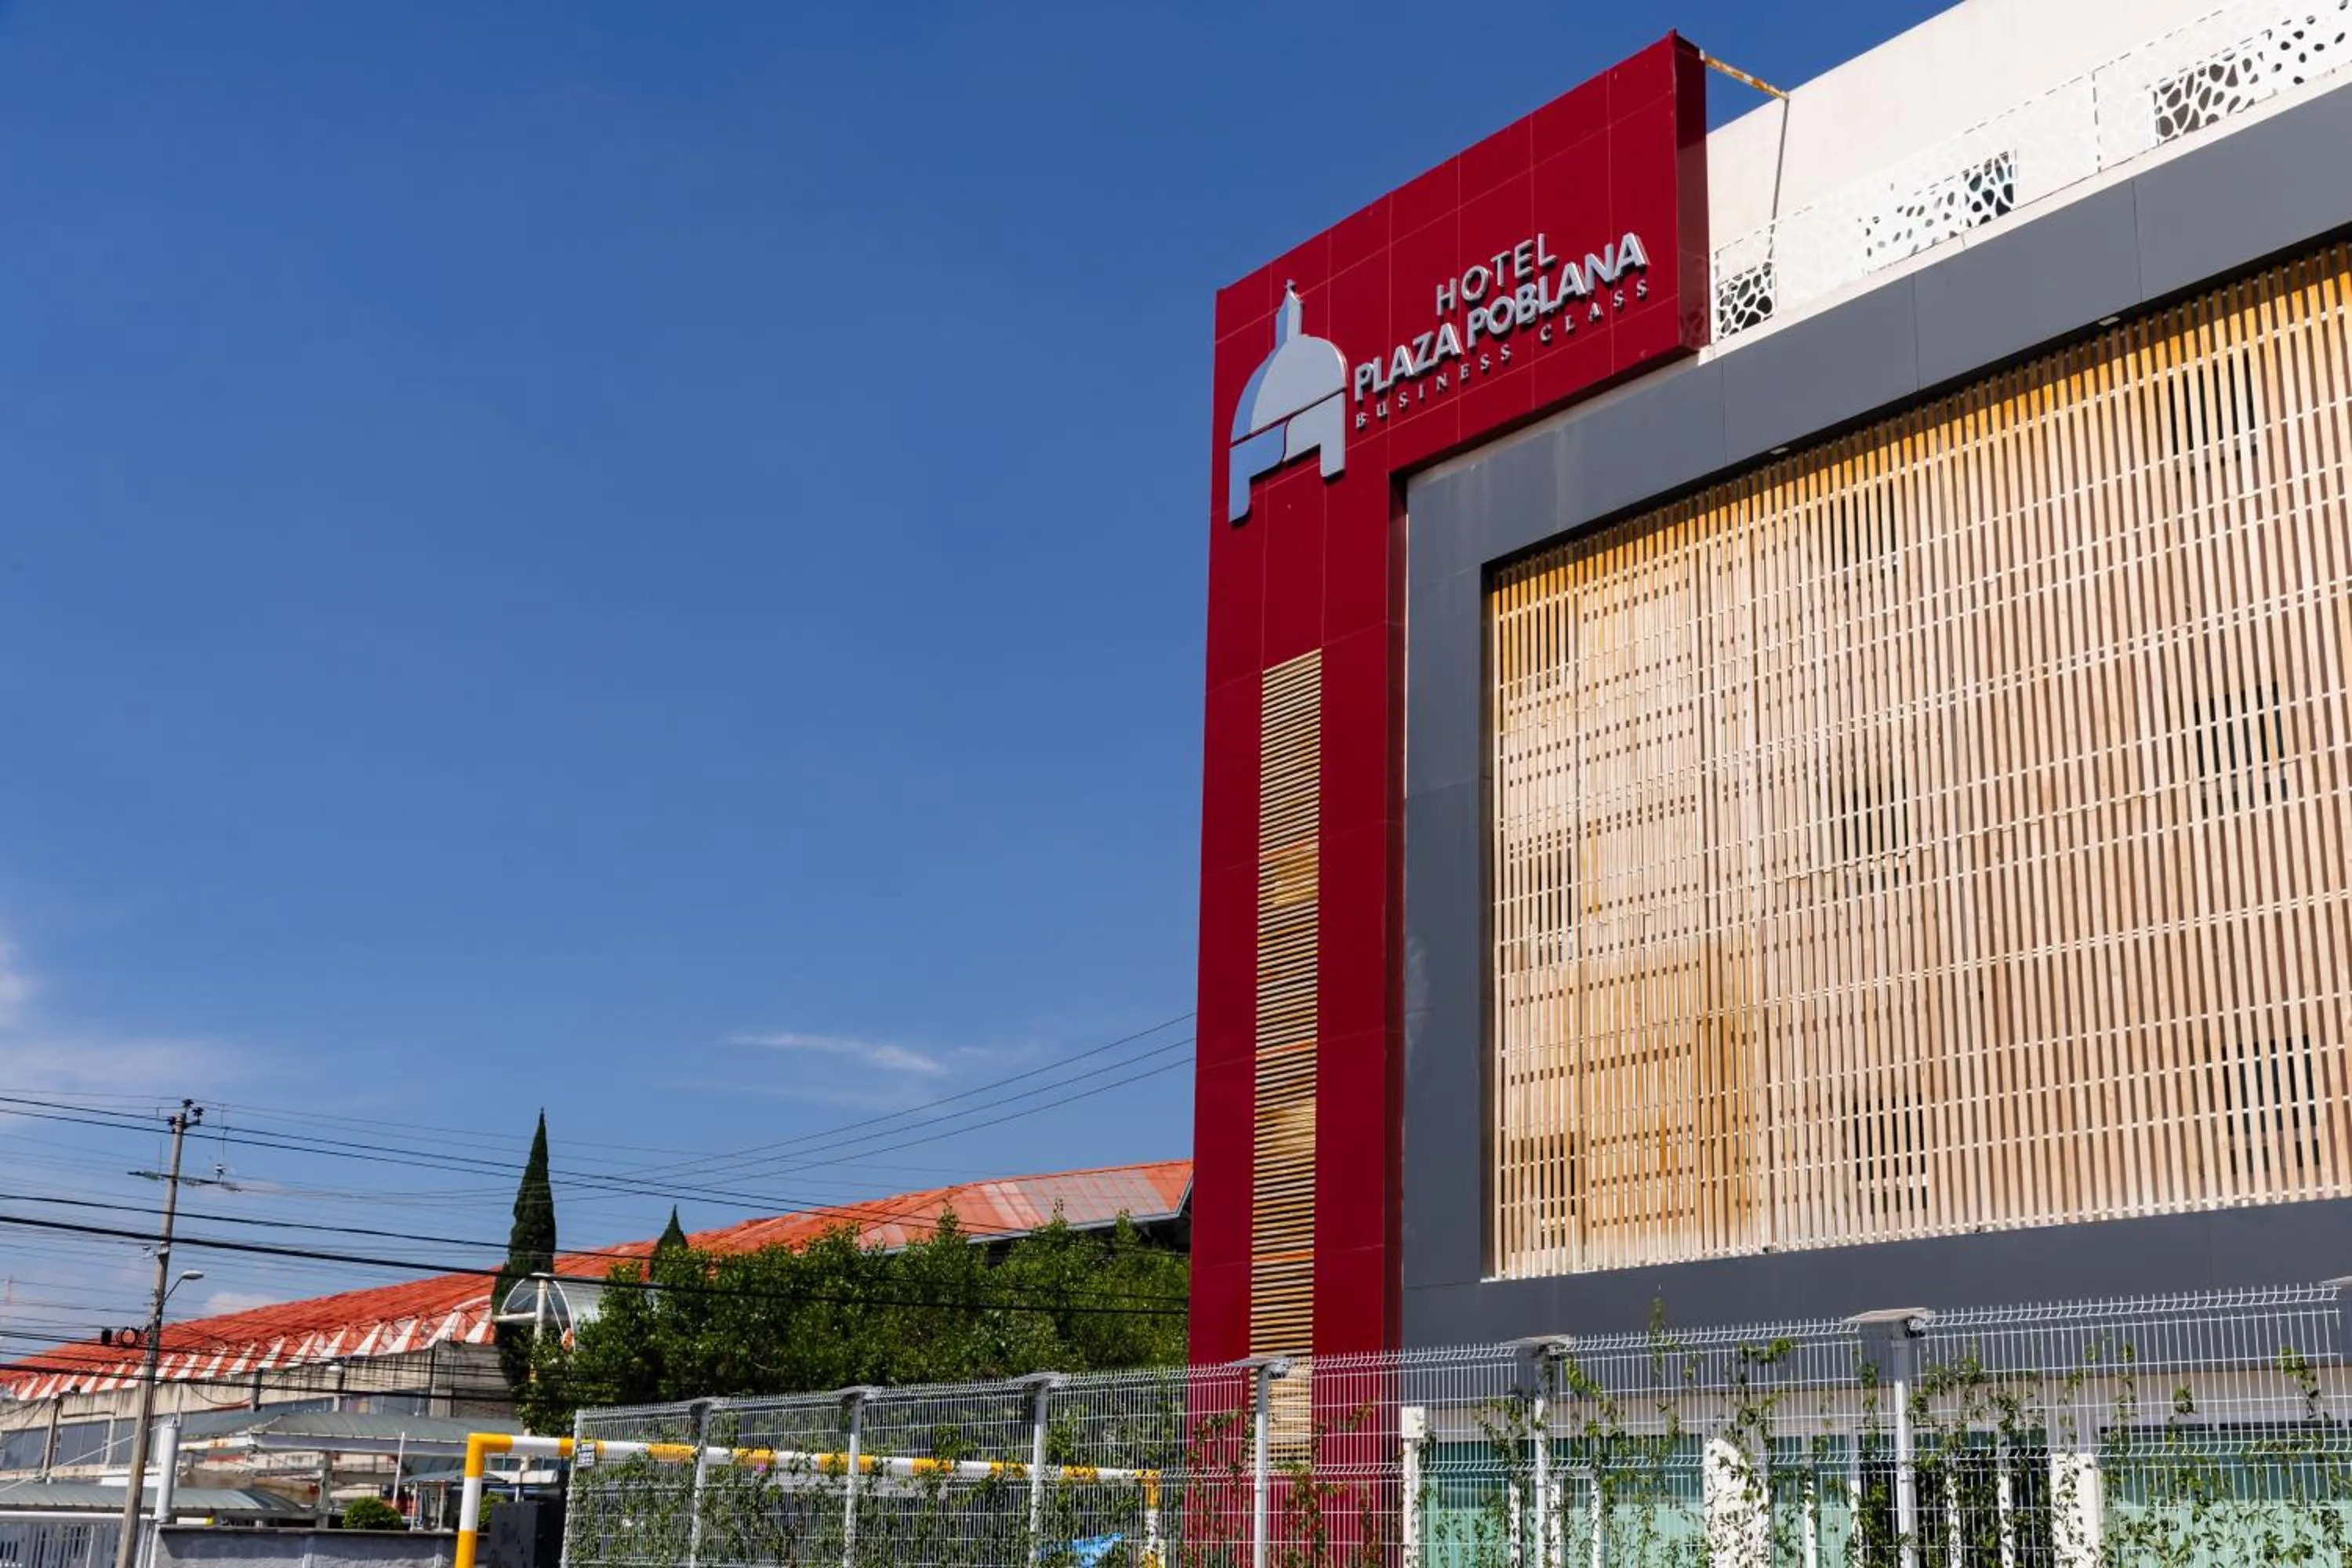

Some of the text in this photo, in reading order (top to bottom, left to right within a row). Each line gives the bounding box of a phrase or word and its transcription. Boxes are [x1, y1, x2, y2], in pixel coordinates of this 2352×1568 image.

[1355, 232, 1648, 402] PLAZA POBLANA
[1436, 233, 1556, 316] HOTEL
[1356, 279, 1649, 429] BUSINESS CLASS
